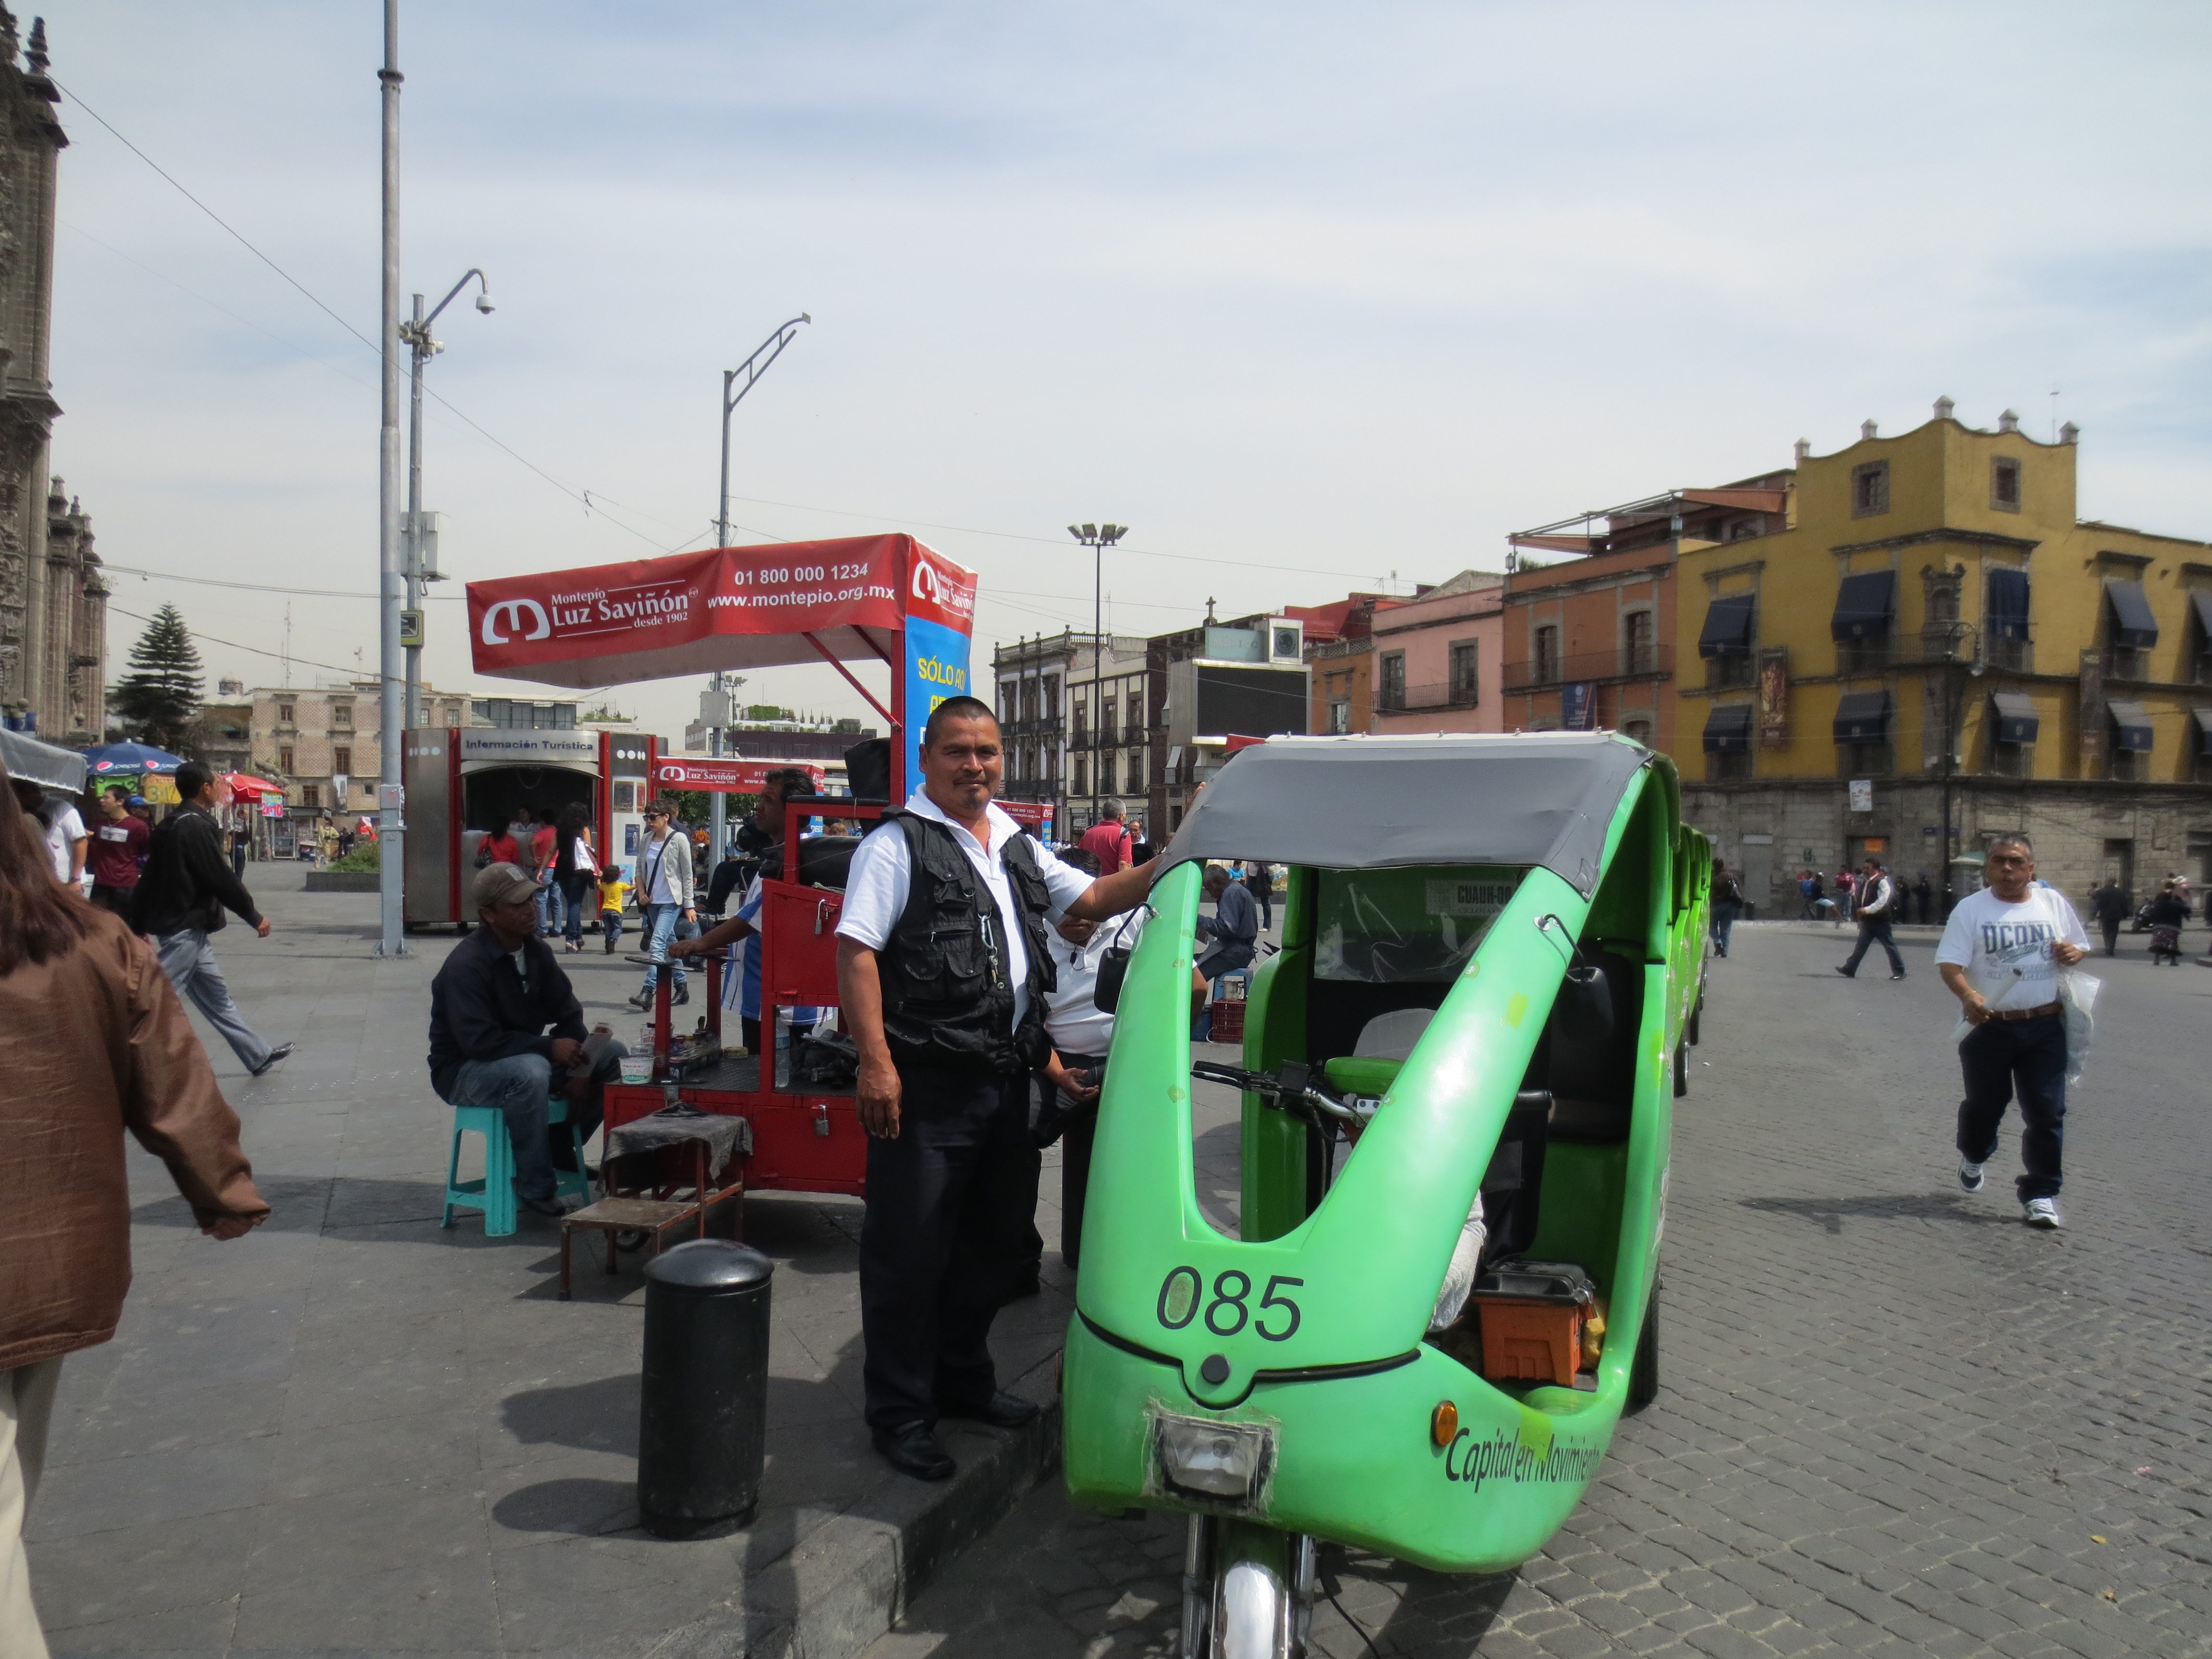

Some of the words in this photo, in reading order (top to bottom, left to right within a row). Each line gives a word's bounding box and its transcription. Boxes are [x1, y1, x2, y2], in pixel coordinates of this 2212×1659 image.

[734, 570, 753, 585] 01
[760, 568, 789, 585] 800
[794, 566, 825, 582] 000
[831, 563, 868, 580] 1234
[708, 585, 896, 609] www.montepio.org.mx
[938, 580, 950, 603] Luz
[553, 606, 592, 627] Luz
[598, 589, 688, 621] Saviñón
[634, 614, 663, 628] desde
[665, 612, 688, 624] 1902
[918, 654, 954, 686] SÓLO
[466, 740, 538, 750] Información
[541, 740, 593, 750] Turística
[686, 771, 701, 780] Luz
[703, 771, 736, 781] Saviñón
[1157, 1265, 1304, 1342] 085
[1445, 1426, 1520, 1494] Capital
[1514, 1444, 1536, 1483] en
